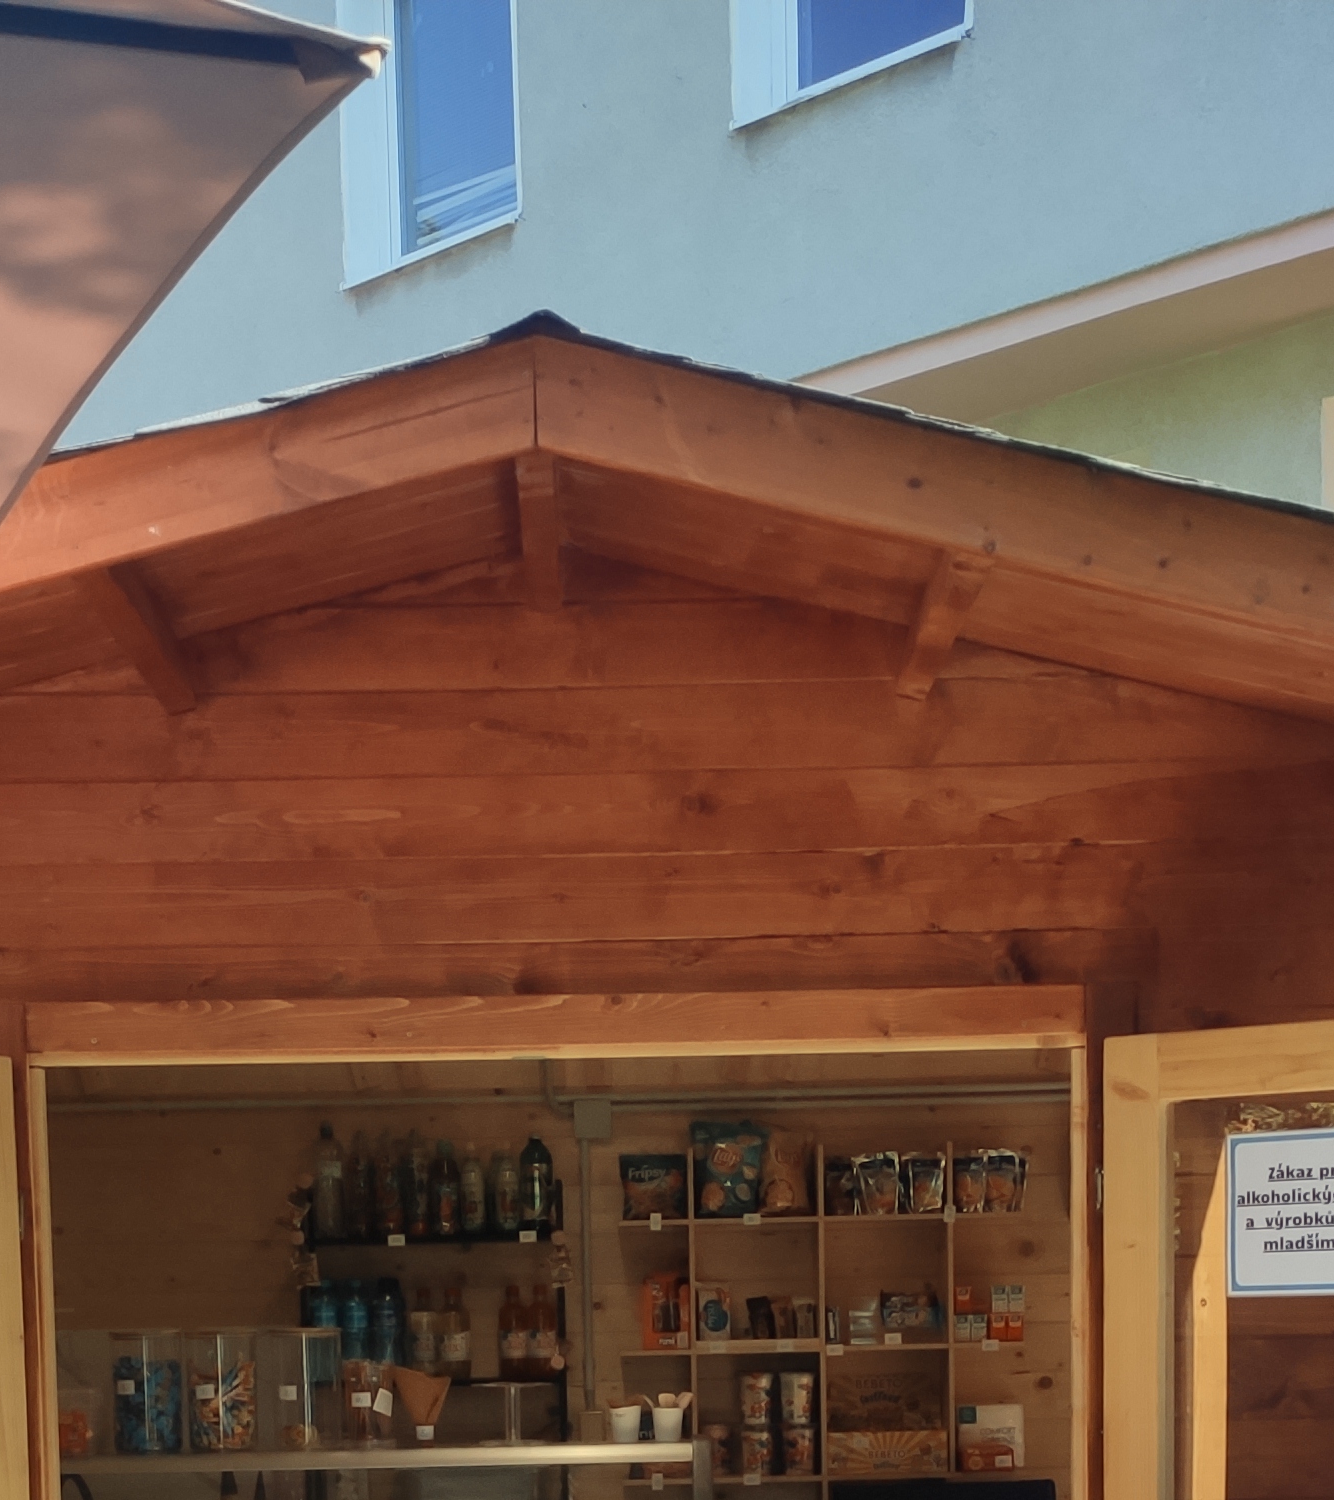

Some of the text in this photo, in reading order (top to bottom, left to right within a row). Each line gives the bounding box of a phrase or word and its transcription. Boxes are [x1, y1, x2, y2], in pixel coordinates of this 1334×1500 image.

[628, 1164, 667, 1182] Fripsy
[1268, 1162, 1314, 1181] Zákaz
[1245, 1217, 1255, 1229] a
[855, 1378, 903, 1390] BEBETO
[868, 1450, 906, 1459] BEBETO
